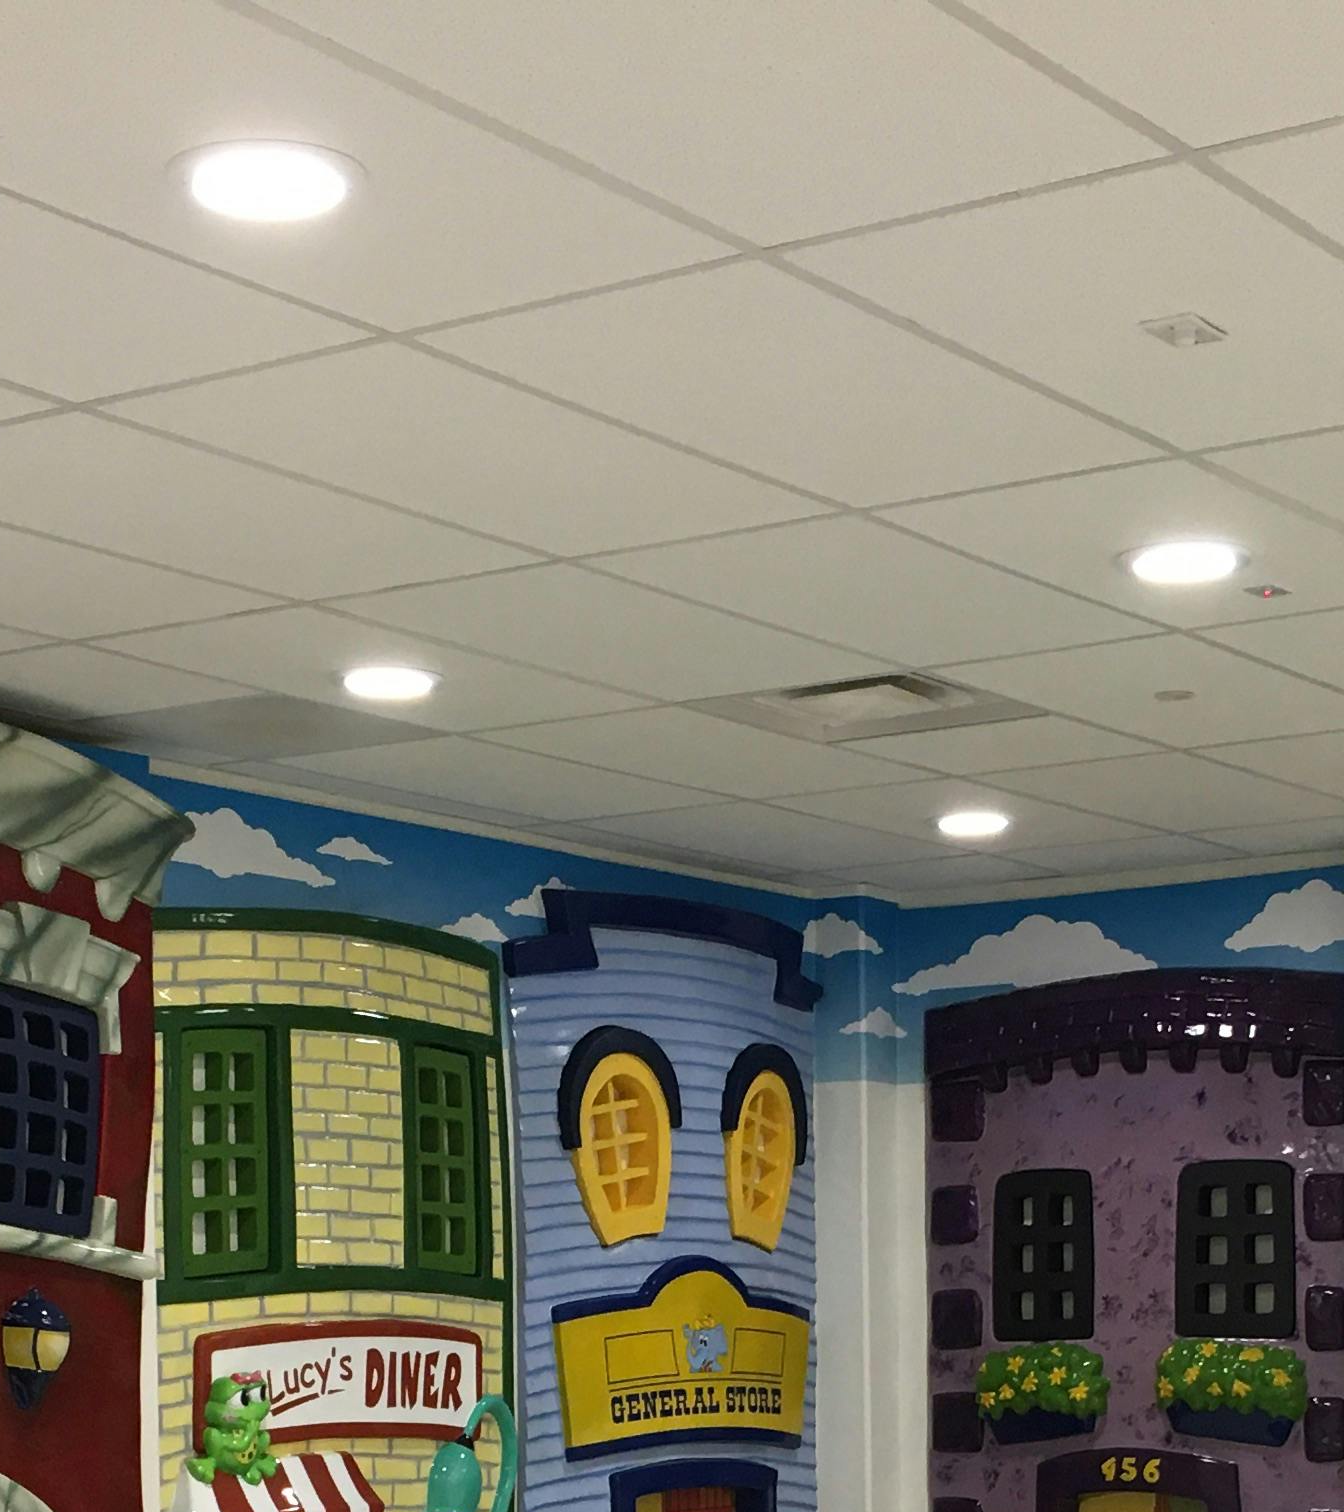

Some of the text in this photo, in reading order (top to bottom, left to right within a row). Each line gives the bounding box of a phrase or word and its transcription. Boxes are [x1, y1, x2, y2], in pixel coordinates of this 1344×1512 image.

[365, 1347, 463, 1412] DINER
[611, 1386, 782, 1424] GENERAL STORE
[1101, 1456, 1161, 1483] 456
